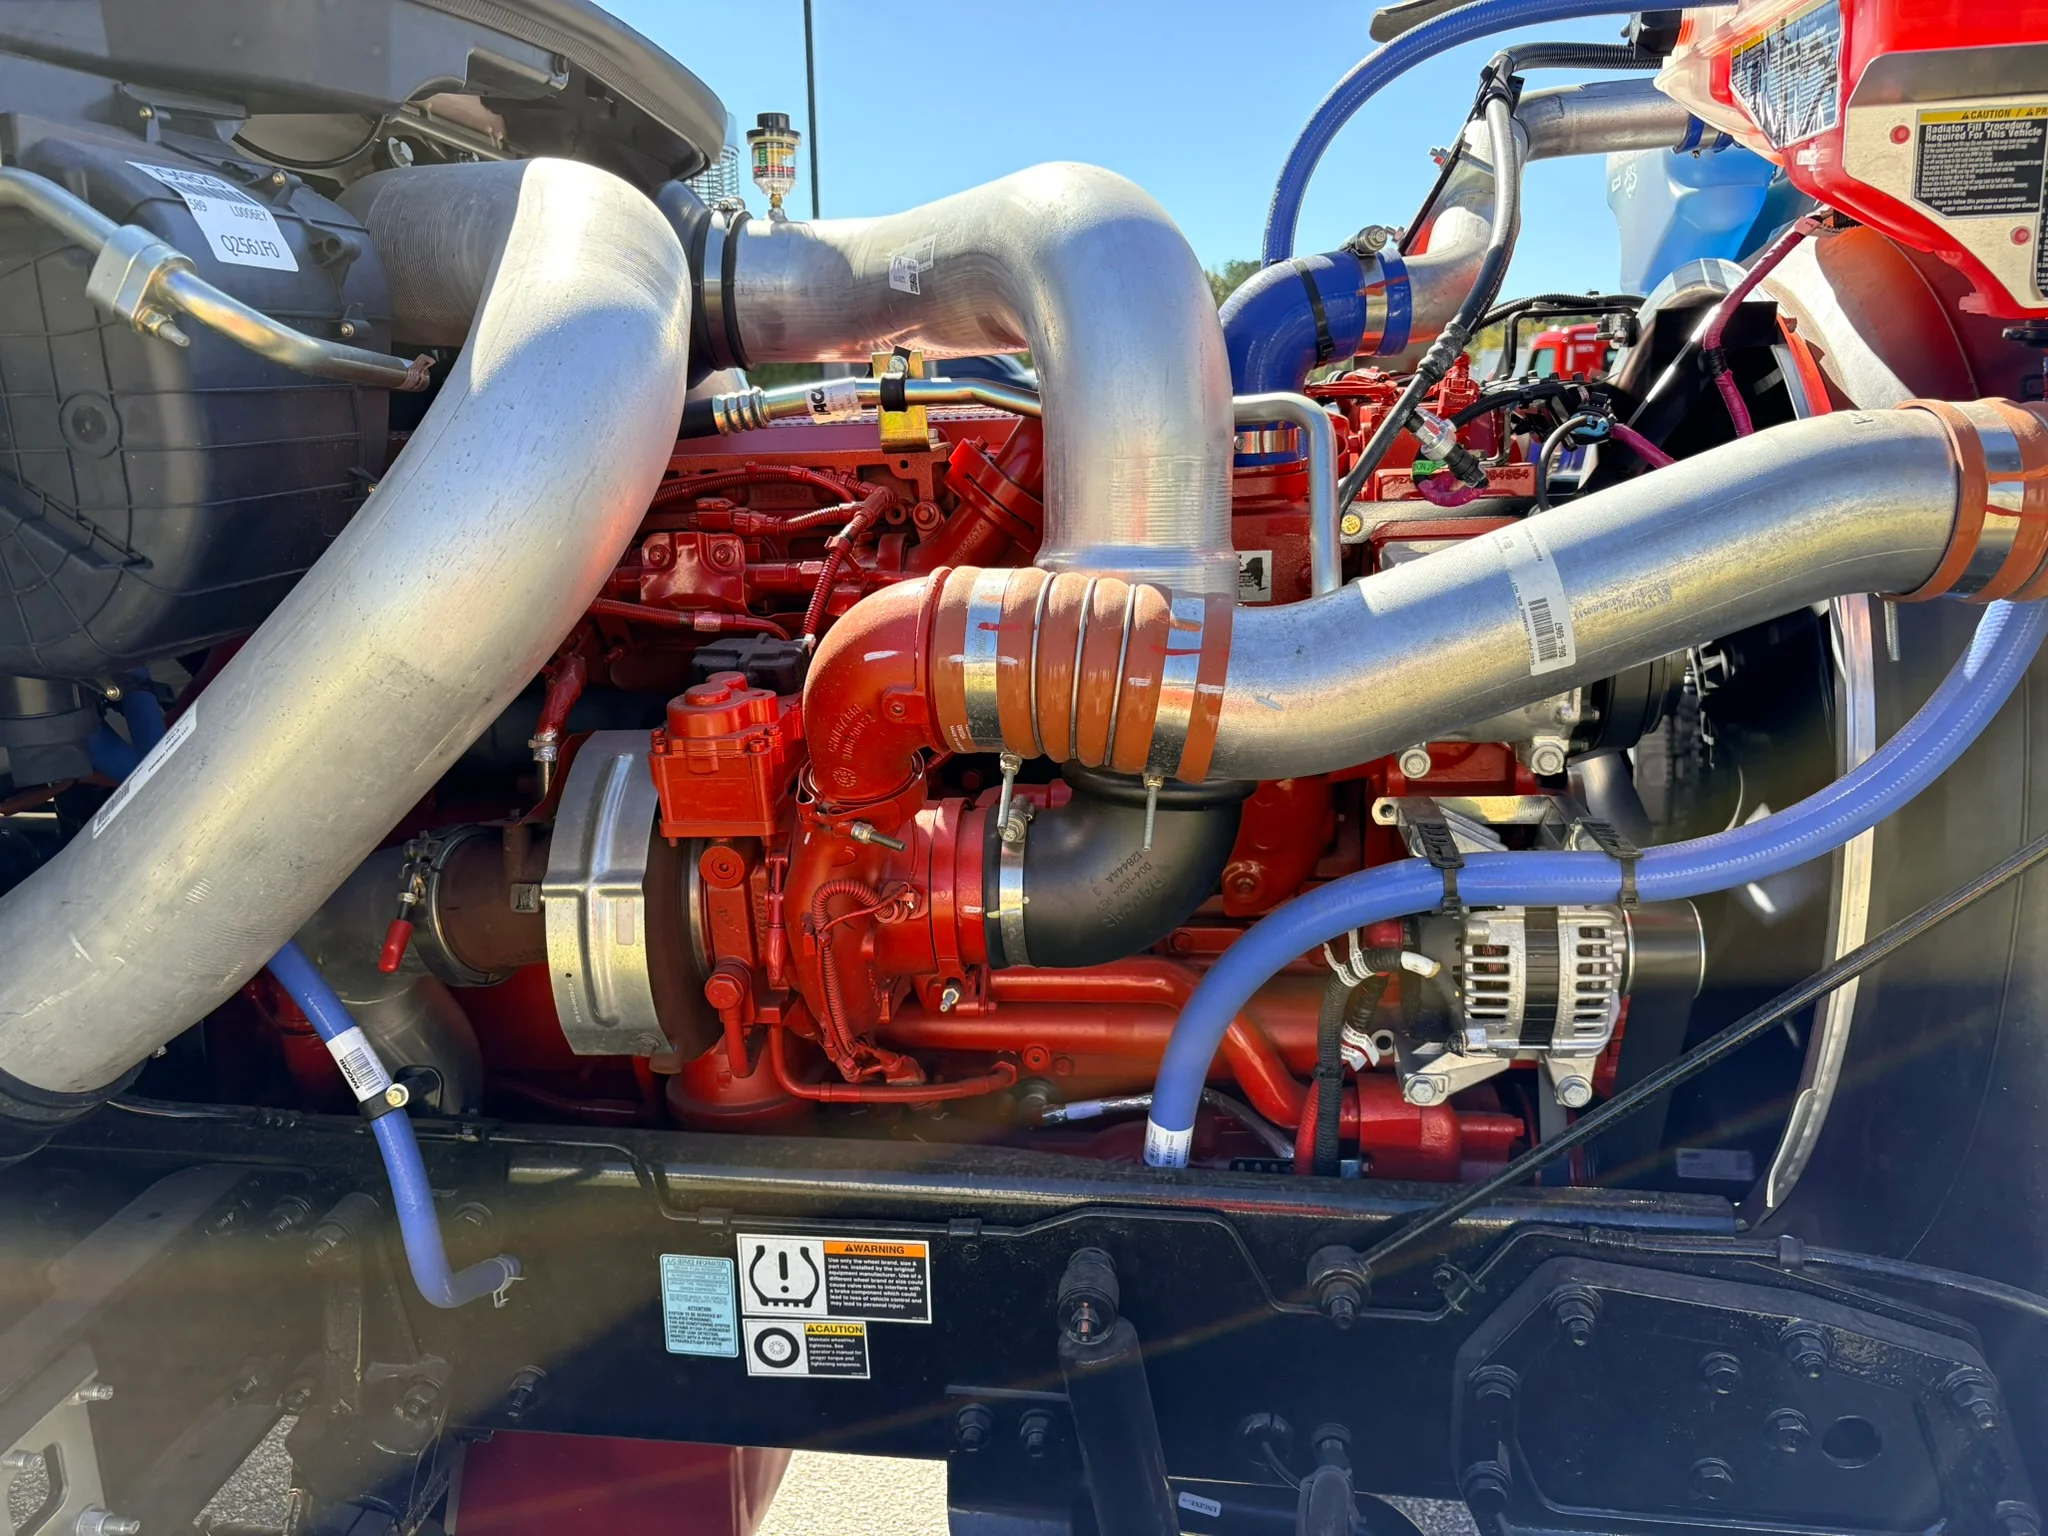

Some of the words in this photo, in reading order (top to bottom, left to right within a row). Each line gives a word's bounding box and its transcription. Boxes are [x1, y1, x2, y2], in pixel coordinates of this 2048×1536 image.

[1971, 110, 2011, 120] CAUTION
[1926, 125, 1964, 133] Radiator
[1967, 123, 1981, 132] Fill
[1984, 121, 2031, 131] Procedure
[1926, 132, 1965, 142] Required
[1987, 130, 2006, 138] This
[2009, 128, 2042, 137] Vehicle
[188, 198, 207, 212] 589
[1105, 850, 1142, 883] 12844AA
[340, 1059, 360, 1089] PACCAR
[854, 1245, 904, 1254] WARNING
[816, 1325, 862, 1333] CAUTION
